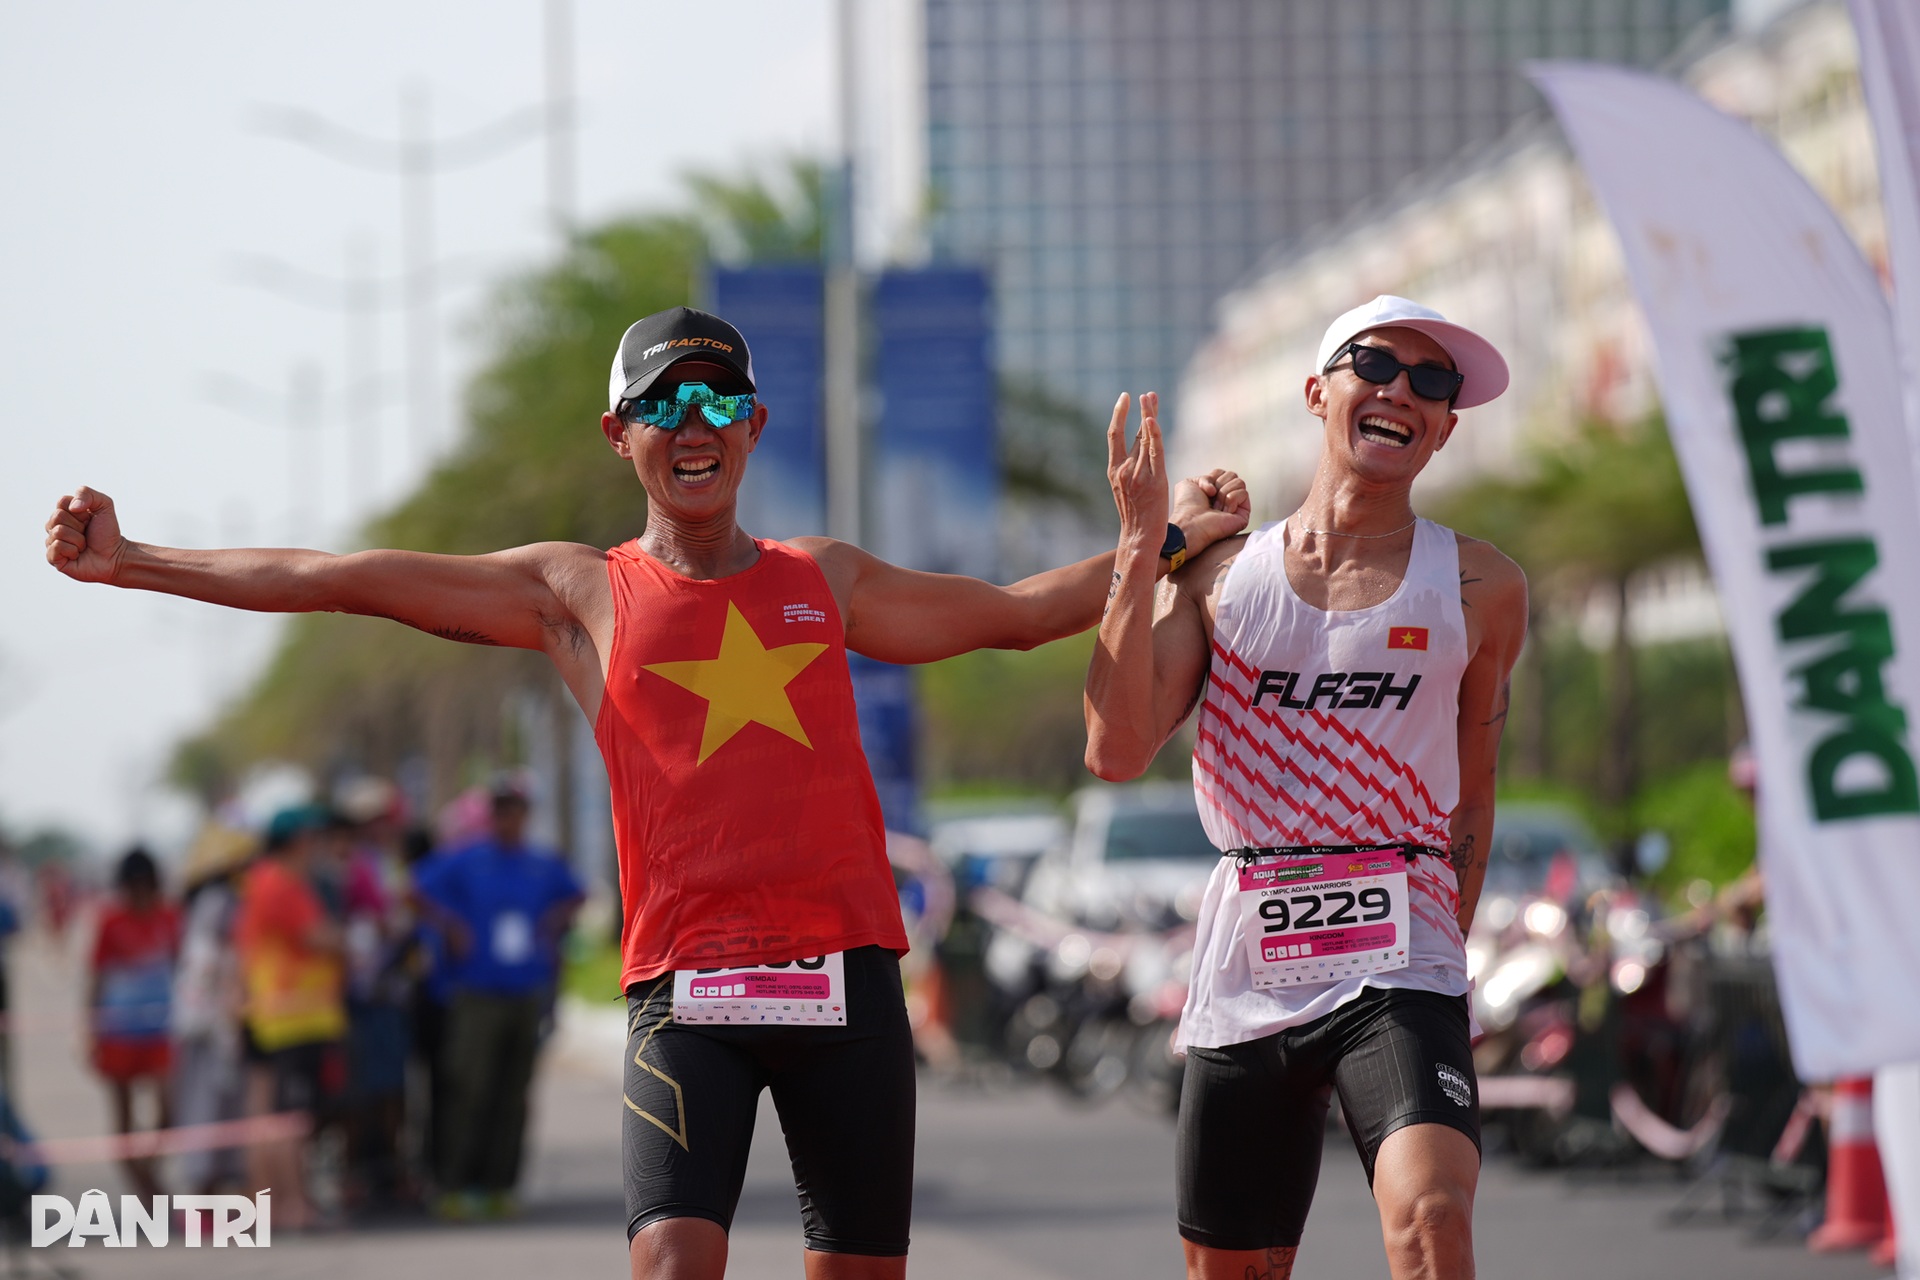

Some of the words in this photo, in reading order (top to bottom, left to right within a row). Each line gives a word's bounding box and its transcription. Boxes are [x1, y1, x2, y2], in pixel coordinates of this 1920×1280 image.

[642, 337, 733, 361] TRIFACTOR
[783, 603, 809, 611] MAKE
[783, 609, 826, 617] RUNNERS
[797, 615, 826, 623] GREAT
[1251, 670, 1422, 711] FLASH
[1252, 869, 1276, 880] AQUA
[1277, 863, 1324, 877] WARRIORS
[1261, 887, 1290, 897] OLYMPIC
[1291, 885, 1311, 894] AQUA
[1312, 880, 1352, 891] WARRIORS
[1258, 887, 1391, 933] 9229
[1309, 931, 1345, 941] KINGDOM
[1437, 1070, 1471, 1096] arena
